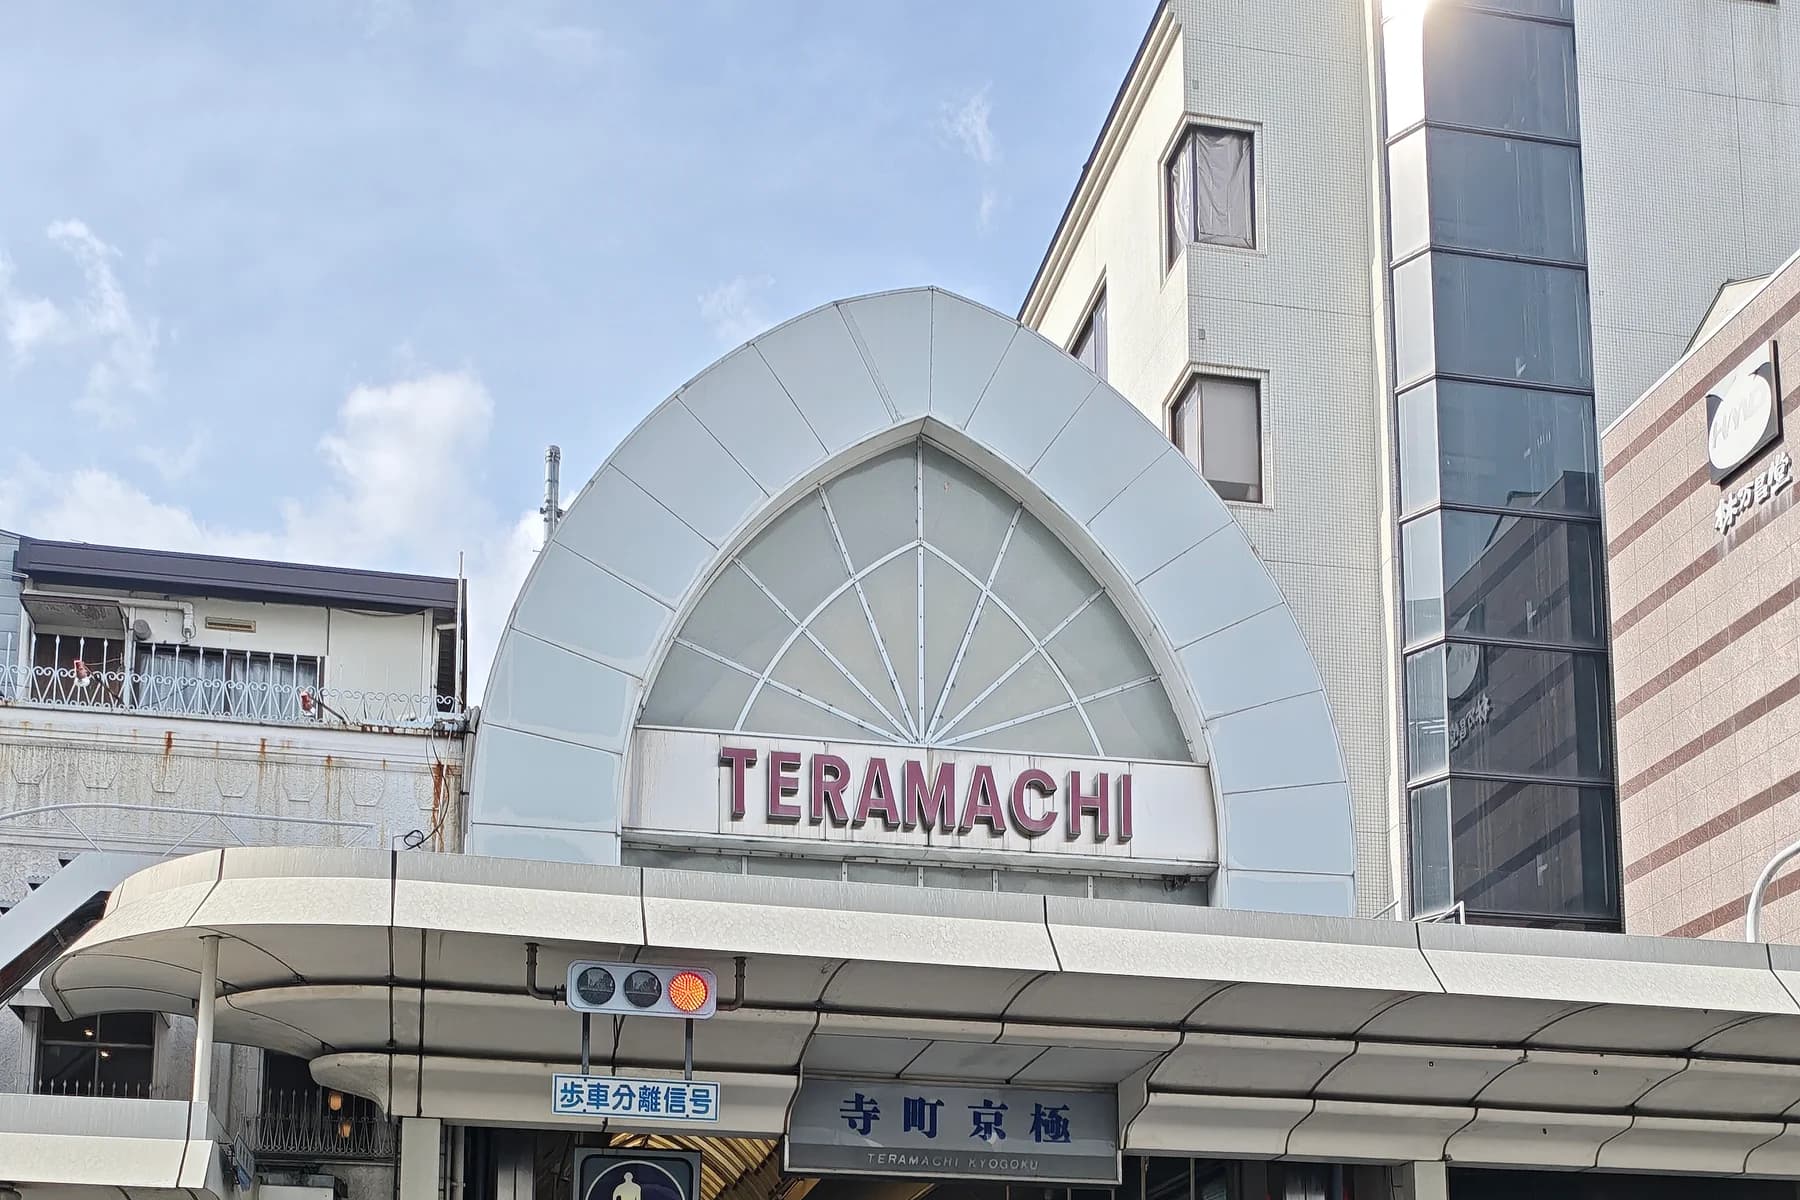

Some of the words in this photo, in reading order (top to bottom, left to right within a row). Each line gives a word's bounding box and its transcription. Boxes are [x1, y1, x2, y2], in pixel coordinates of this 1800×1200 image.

[720, 746, 1132, 843] TERAMACHI
[560, 1081, 712, 1114] 歩車分離信号
[839, 1092, 1072, 1143] 寺町京極
[868, 1153, 959, 1168] TERAMACHI
[968, 1158, 1039, 1171] KYOGOKU
